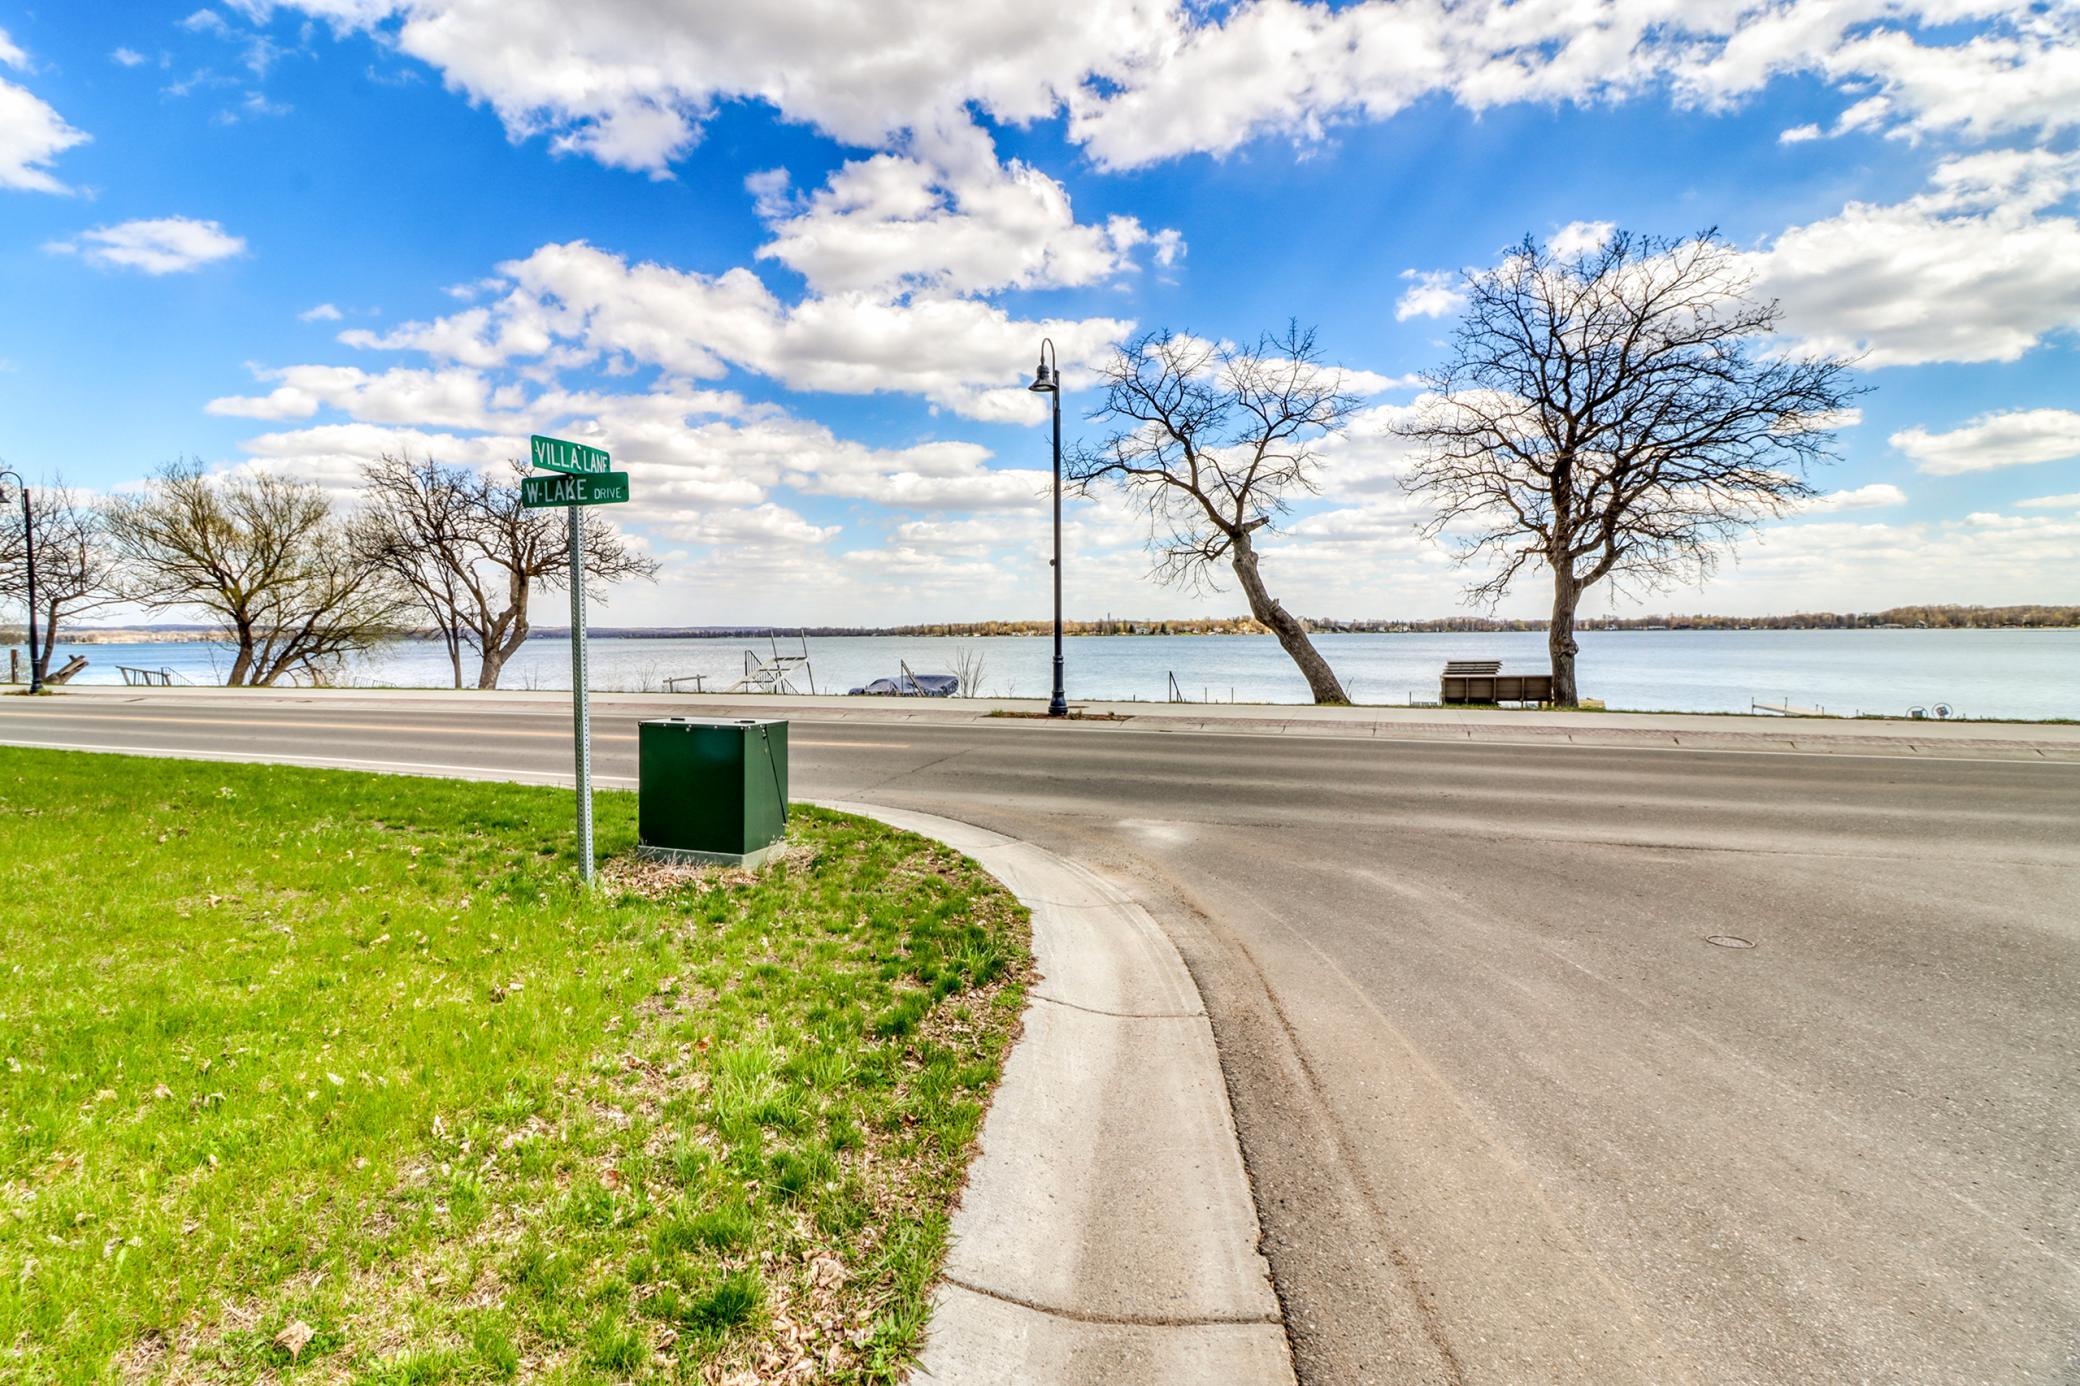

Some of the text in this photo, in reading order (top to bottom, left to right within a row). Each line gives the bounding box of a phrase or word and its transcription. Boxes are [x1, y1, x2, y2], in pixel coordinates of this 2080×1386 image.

[535, 440, 608, 473] VILLA LANE
[594, 487, 622, 500] DRIVE
